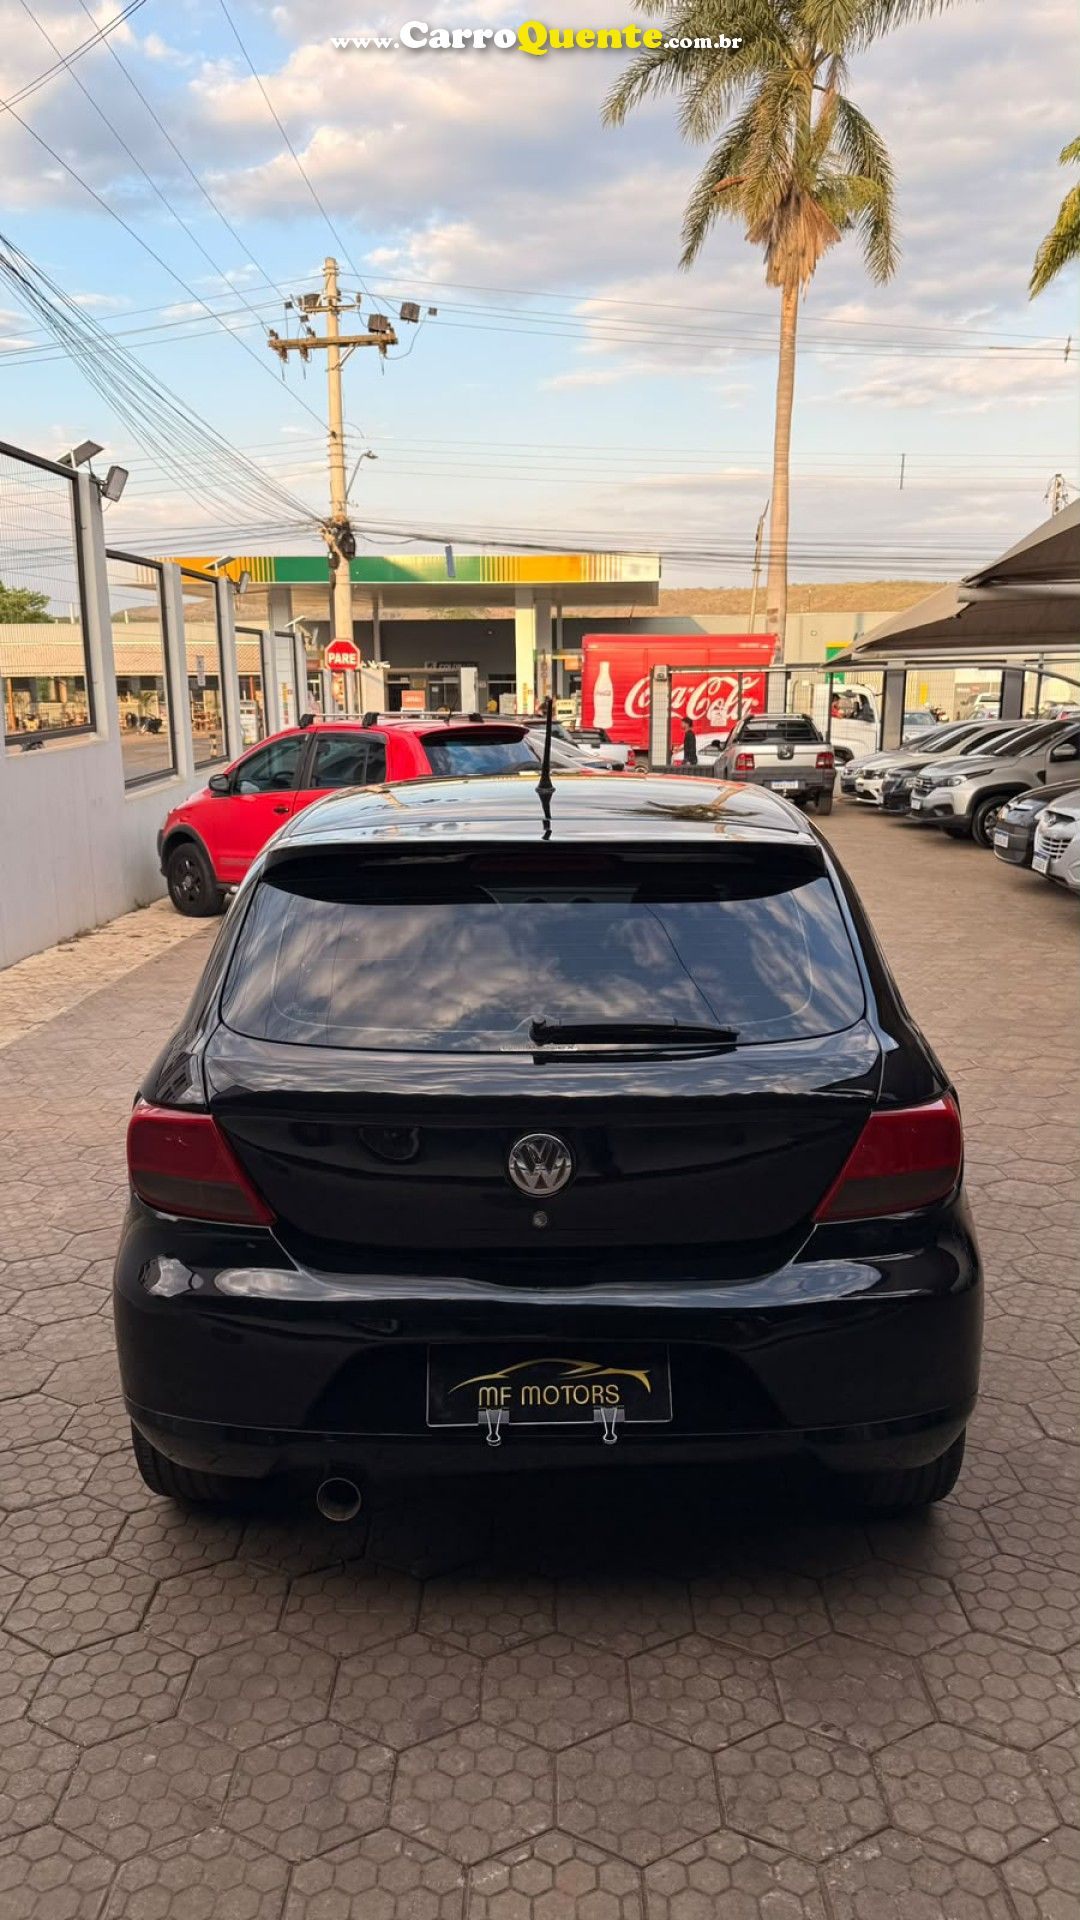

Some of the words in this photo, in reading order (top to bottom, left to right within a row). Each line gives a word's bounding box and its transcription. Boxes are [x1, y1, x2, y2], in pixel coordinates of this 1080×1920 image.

[329, 652, 356, 665] PARE
[624, 676, 760, 720] Coa-Cola
[479, 1386, 512, 1406] MF
[521, 1384, 620, 1406] MOTORS
